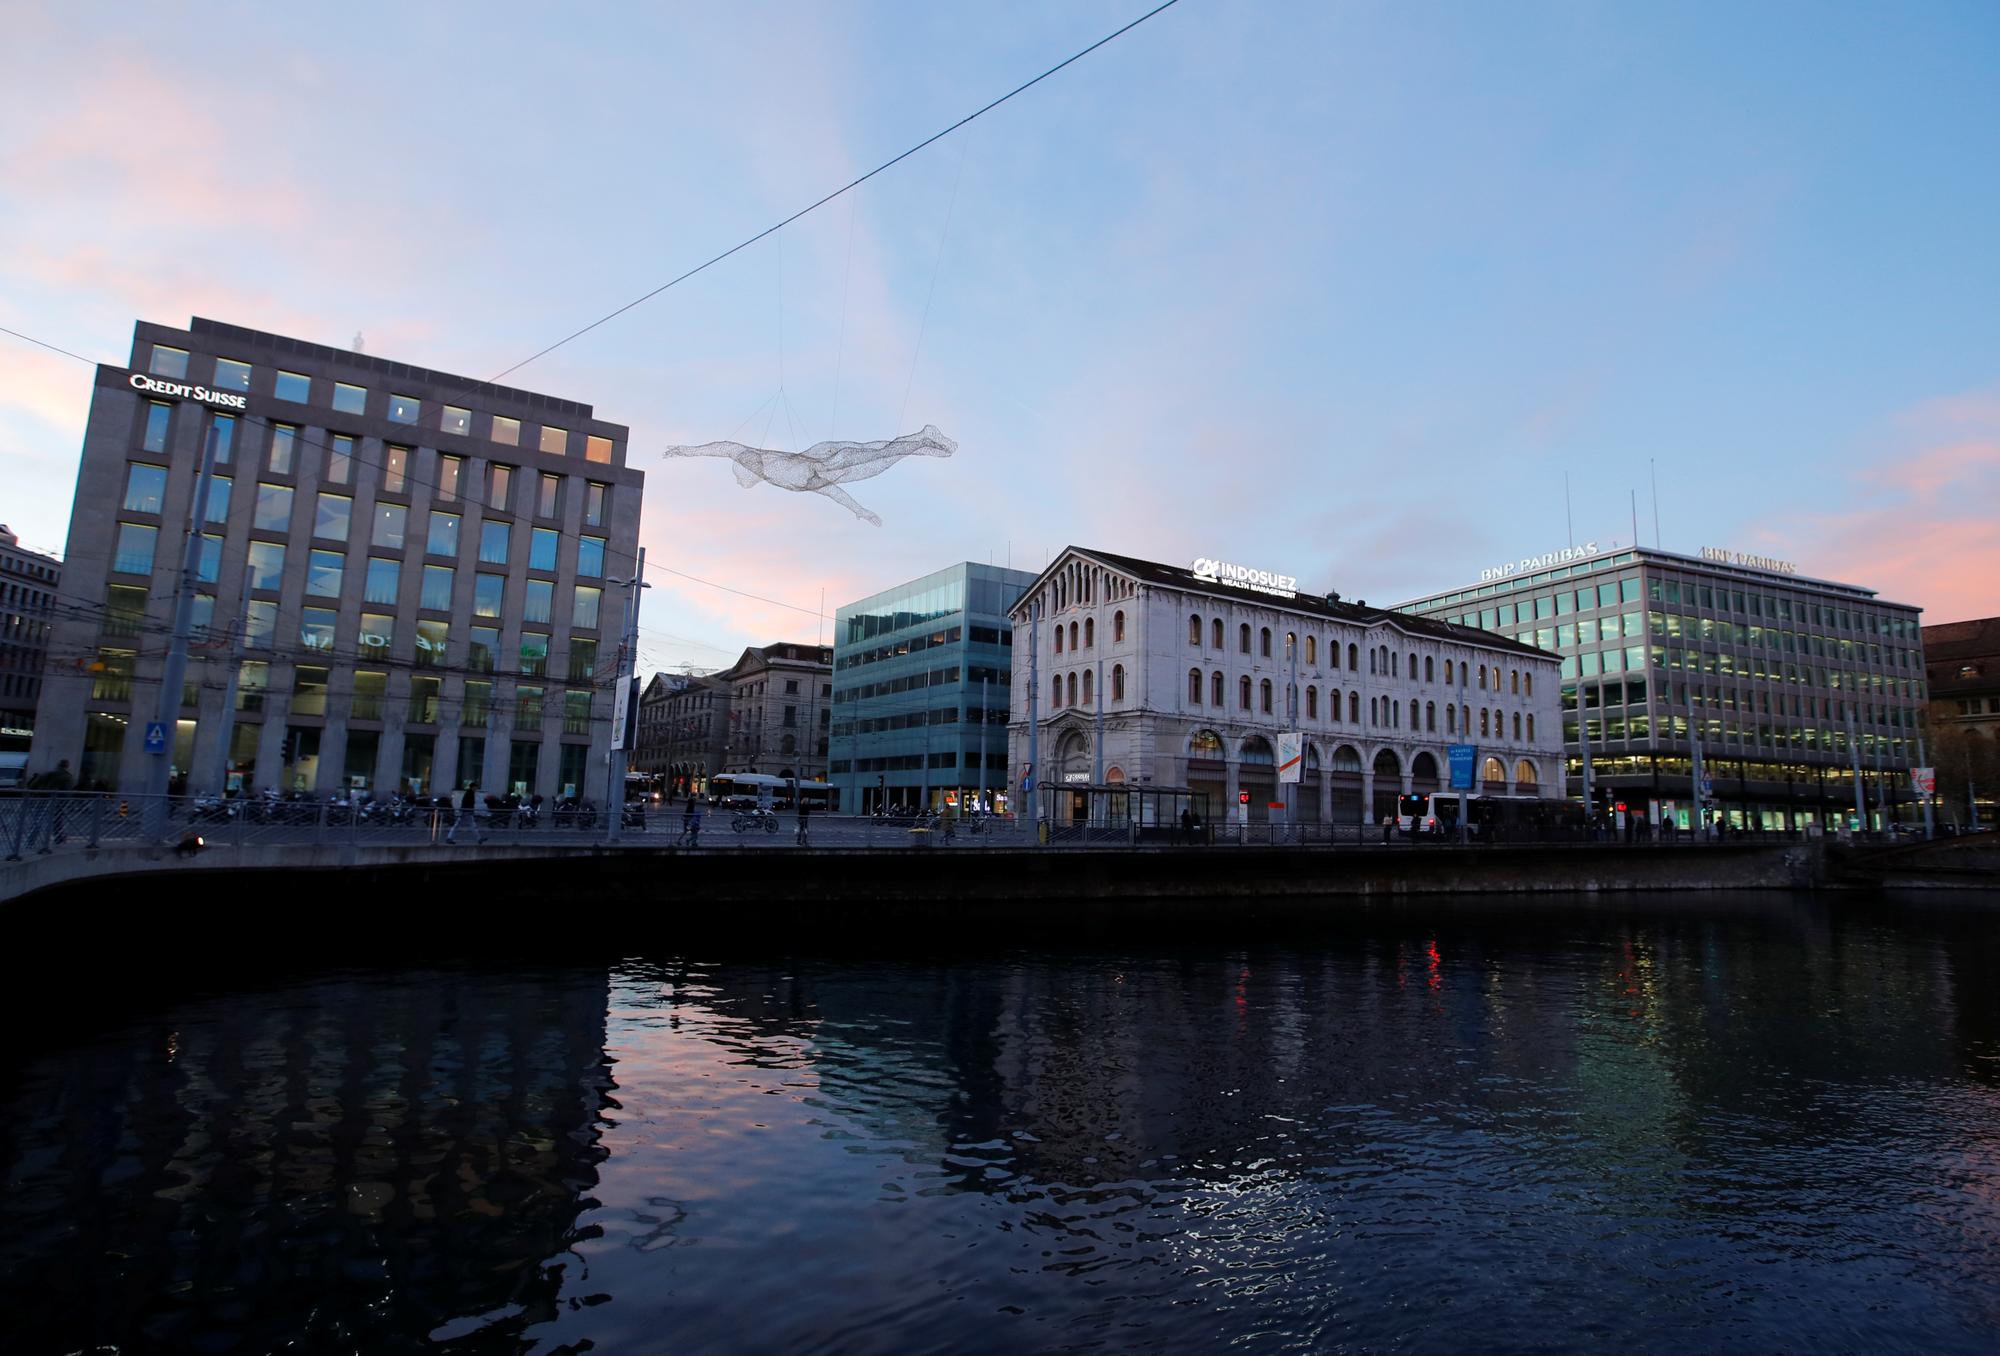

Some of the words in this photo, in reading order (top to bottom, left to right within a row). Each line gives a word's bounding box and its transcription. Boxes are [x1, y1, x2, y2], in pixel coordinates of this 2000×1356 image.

[129, 374, 193, 398] CREDIT
[193, 386, 247, 409] SUISSE
[1481, 563, 1514, 581] BNP
[1520, 542, 1598, 571] PARIBAS
[1737, 553, 1797, 573] PARIBAS
[1221, 562, 1297, 591] INDOSUEZ
[1221, 578, 1249, 590] WEALTH
[1250, 583, 1297, 599] MANAGEMENT
